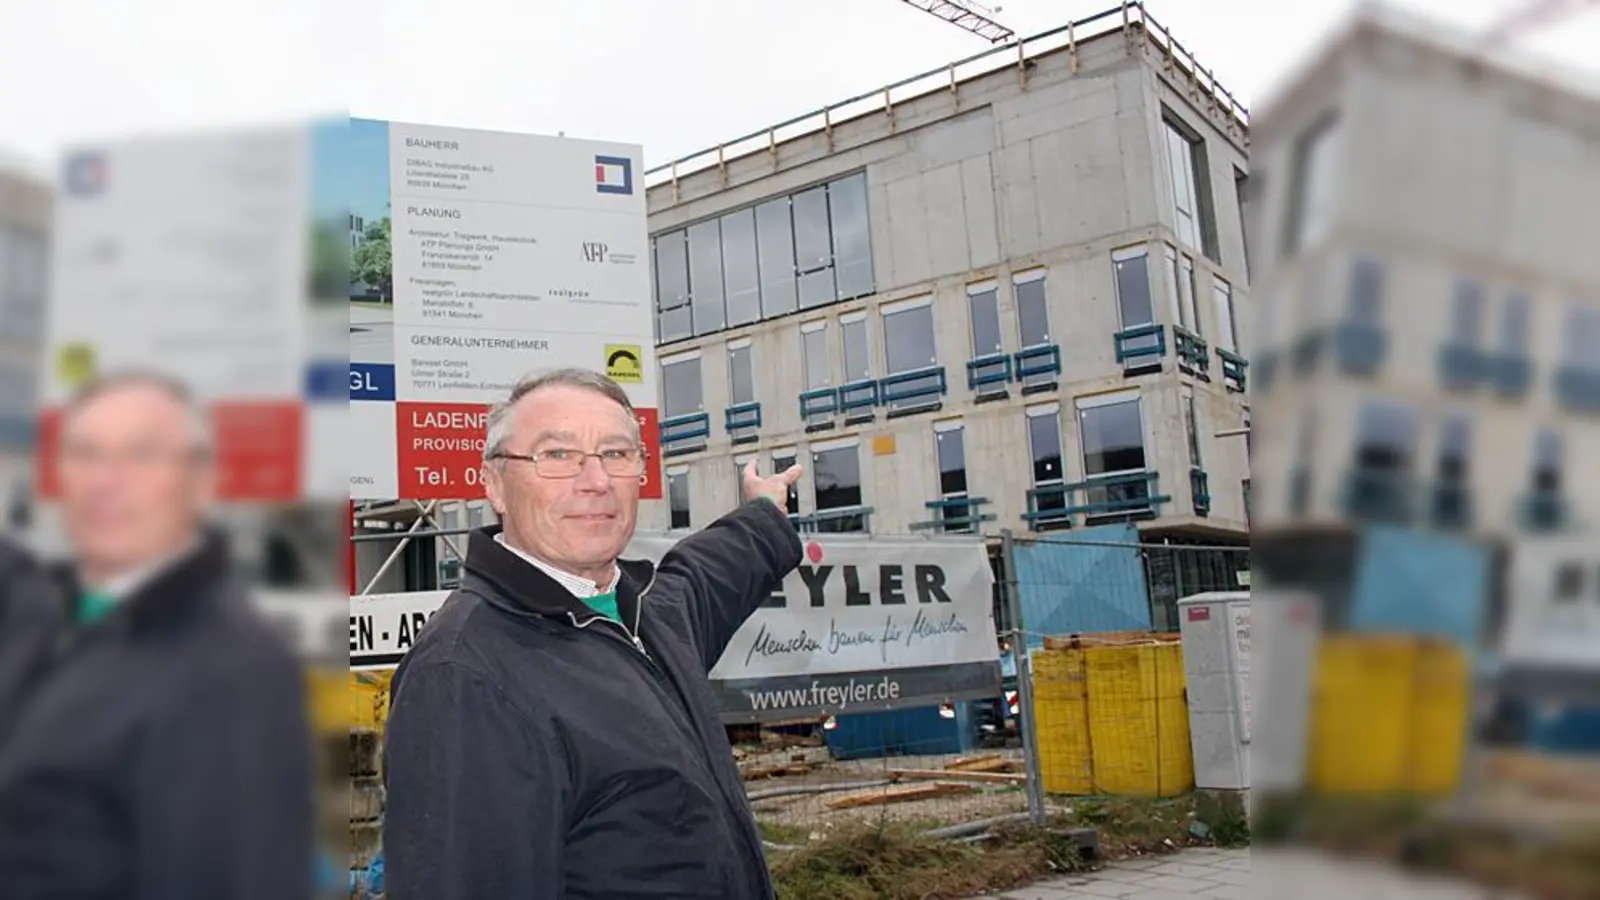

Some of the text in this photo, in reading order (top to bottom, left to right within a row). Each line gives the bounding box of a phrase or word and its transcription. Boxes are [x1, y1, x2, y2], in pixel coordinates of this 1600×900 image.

[405, 138, 460, 150] BAUHERR
[407, 206, 461, 219] PLANUNG
[410, 335, 549, 351] GENERALUNTERNEHMER
[413, 466, 456, 485] Tel.
[745, 608, 969, 667] Menschen bauen für Menschen
[750, 675, 900, 710] www.freyler.de
